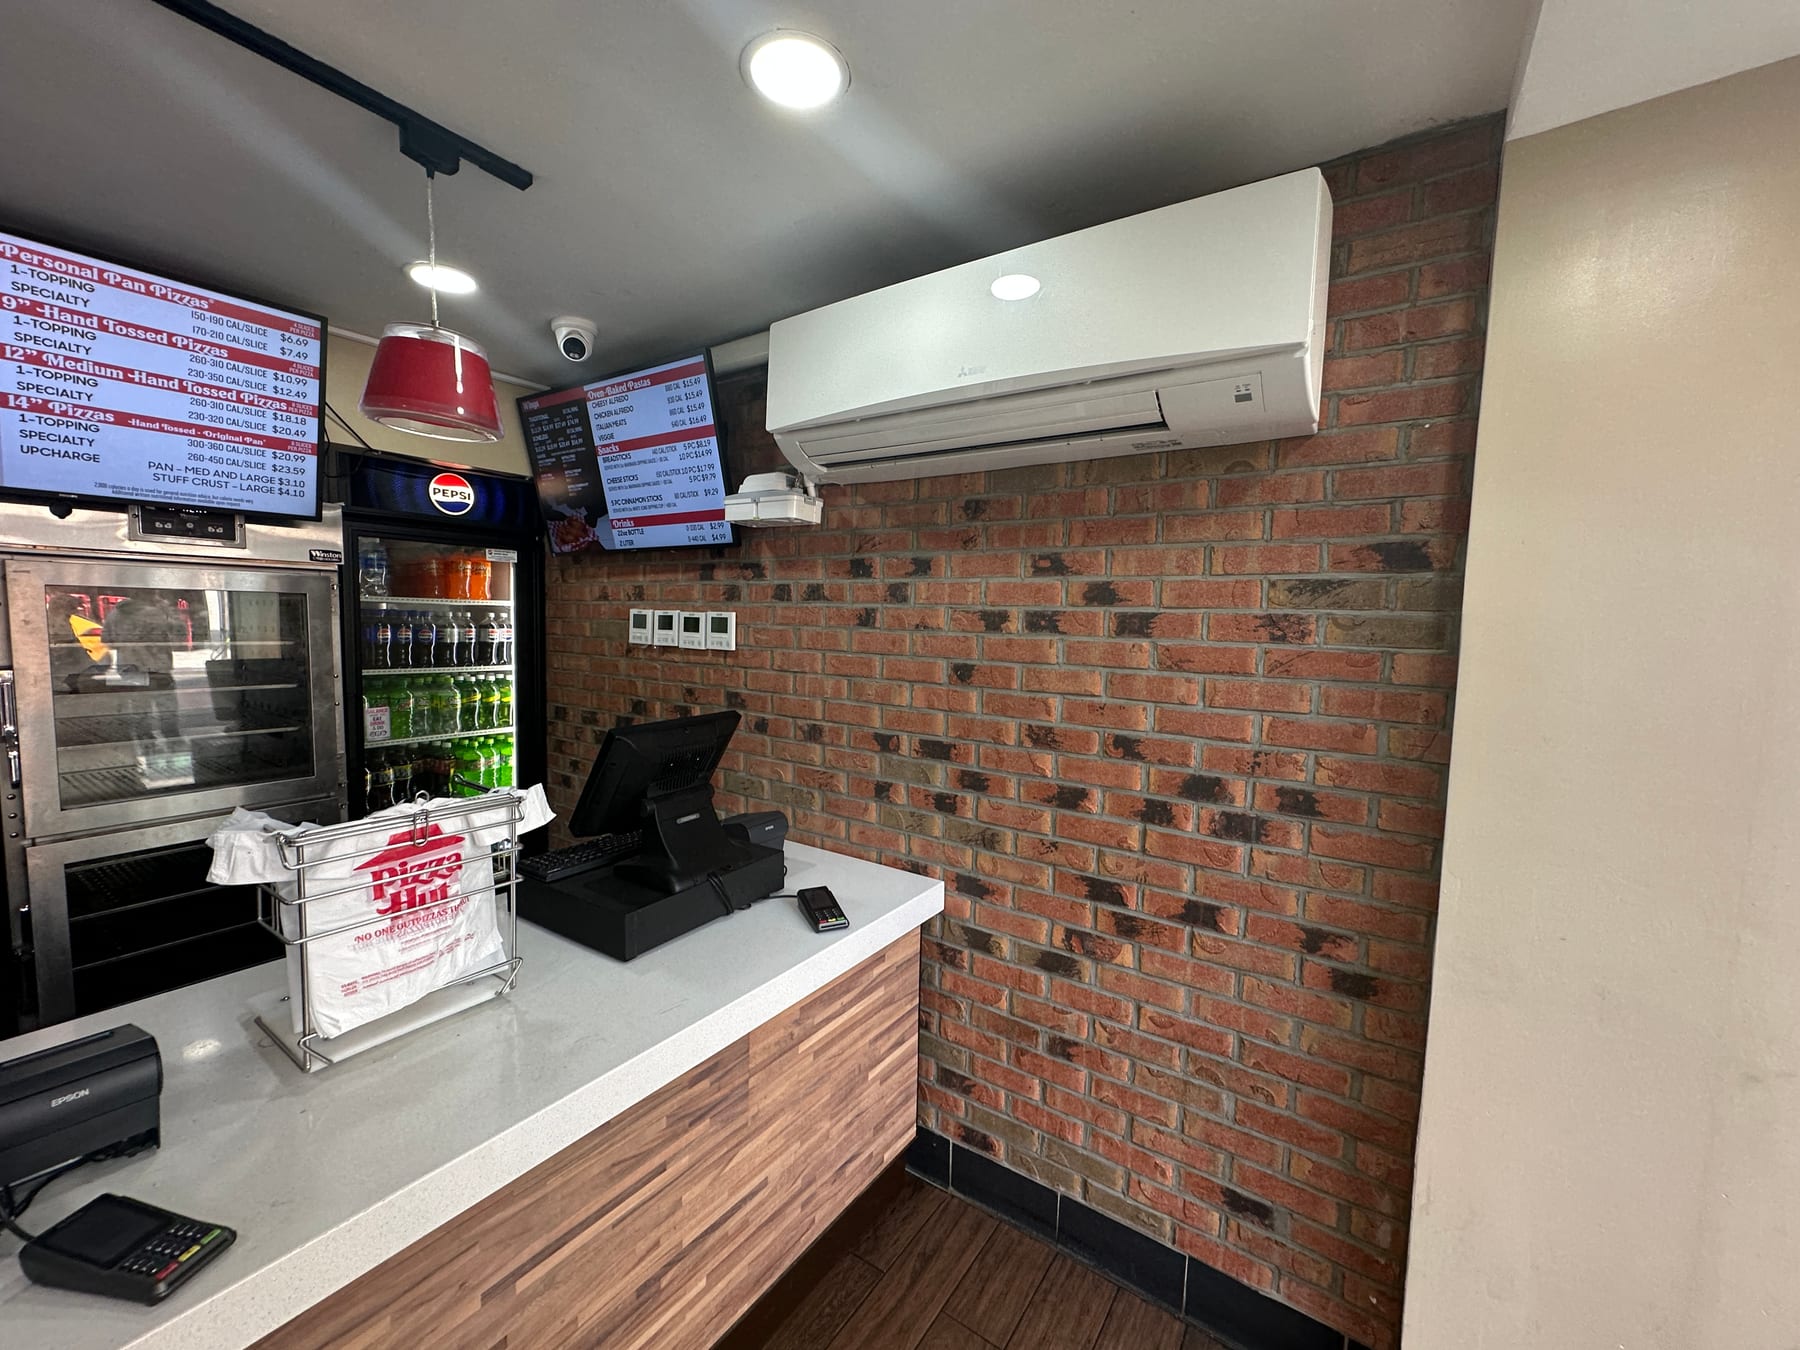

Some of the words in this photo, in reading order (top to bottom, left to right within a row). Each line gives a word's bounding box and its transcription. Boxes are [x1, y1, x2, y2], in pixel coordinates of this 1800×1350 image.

[0, 243, 99, 281] Personal
[103, 271, 145, 293] Pan
[149, 285, 209, 310] Pizzas
[10, 264, 95, 293] 1-TOPPING
[11, 281, 90, 308] SPECIALTY
[13, 315, 97, 341] 1-TOPPING
[36, 304, 99, 328] Hand
[103, 318, 168, 345] Tossed
[172, 335, 228, 358] Pizzas
[191, 310, 224, 326] 150-190
[226, 318, 268, 337] CAL/SLICE
[280, 333, 309, 347] $6.69
[14, 331, 92, 355] SPECIALTY
[192, 325, 224, 341] 170-210
[226, 333, 268, 351] CAL/SLICE
[280, 346, 309, 360] $7.49
[16, 365, 98, 387] 1-TOPPING
[42, 353, 124, 379] Medium
[127, 370, 179, 391] Hand
[183, 380, 237, 401] Tossed
[240, 392, 288, 411] Pizzas
[189, 354, 224, 369] 260-310
[226, 361, 267, 378] CAL/SLICE
[272, 372, 308, 387] $10.99
[17, 381, 93, 402] SPECIALTY
[187, 368, 224, 383] 230-350
[226, 375, 267, 392] CAL/SLICE
[272, 385, 308, 400] $12.49
[587, 382, 627, 400] Oven-Baked
[627, 379, 651, 390] Pastas
[190, 397, 224, 411] 260-310
[226, 403, 267, 419] CAL/SLICE
[272, 412, 307, 426] $18.18
[592, 400, 608, 409] CHEESY
[609, 394, 629, 405] ALFREDO
[593, 410, 613, 420] CHICKEN
[613, 405, 634, 416] ALFREDO
[18, 413, 100, 433] 1-TOPPING
[47, 402, 115, 422] Pizzas
[128, 418, 160, 431] Hand
[161, 423, 196, 436] Tossed
[202, 430, 243, 444] Original
[188, 411, 224, 424] 230-320
[226, 417, 267, 432] CAL/SLICE
[272, 425, 307, 438] $20.49
[19, 429, 95, 447] SPECIALTY
[598, 432, 615, 442] VEGGIE
[20, 444, 100, 463] UPCHARGE
[187, 438, 224, 451] 300-360
[226, 444, 266, 458] CAL/SLICE
[271, 451, 306, 464] $20.99
[148, 461, 174, 472] PAN
[184, 466, 210, 476] MED
[213, 469, 238, 480] AND
[240, 472, 276, 485] LARGE
[278, 477, 305, 488] $3.10
[187, 453, 224, 465] 260-450
[226, 458, 266, 471] CAL/SLICE
[271, 463, 306, 476] $23.59
[153, 472, 189, 487] STUFF
[191, 477, 230, 490] CRUST
[240, 483, 276, 495] LARGE
[278, 487, 305, 498] $4.10
[433, 487, 471, 501] PEPSI
[612, 519, 634, 529] Drinks
[310, 550, 342, 559] Winston
[370, 852, 463, 901] Pizza
[376, 881, 451, 919] Hut
[354, 931, 372, 944] NO
[374, 925, 396, 938] ONE
[51, 1088, 89, 1108] EPSON
